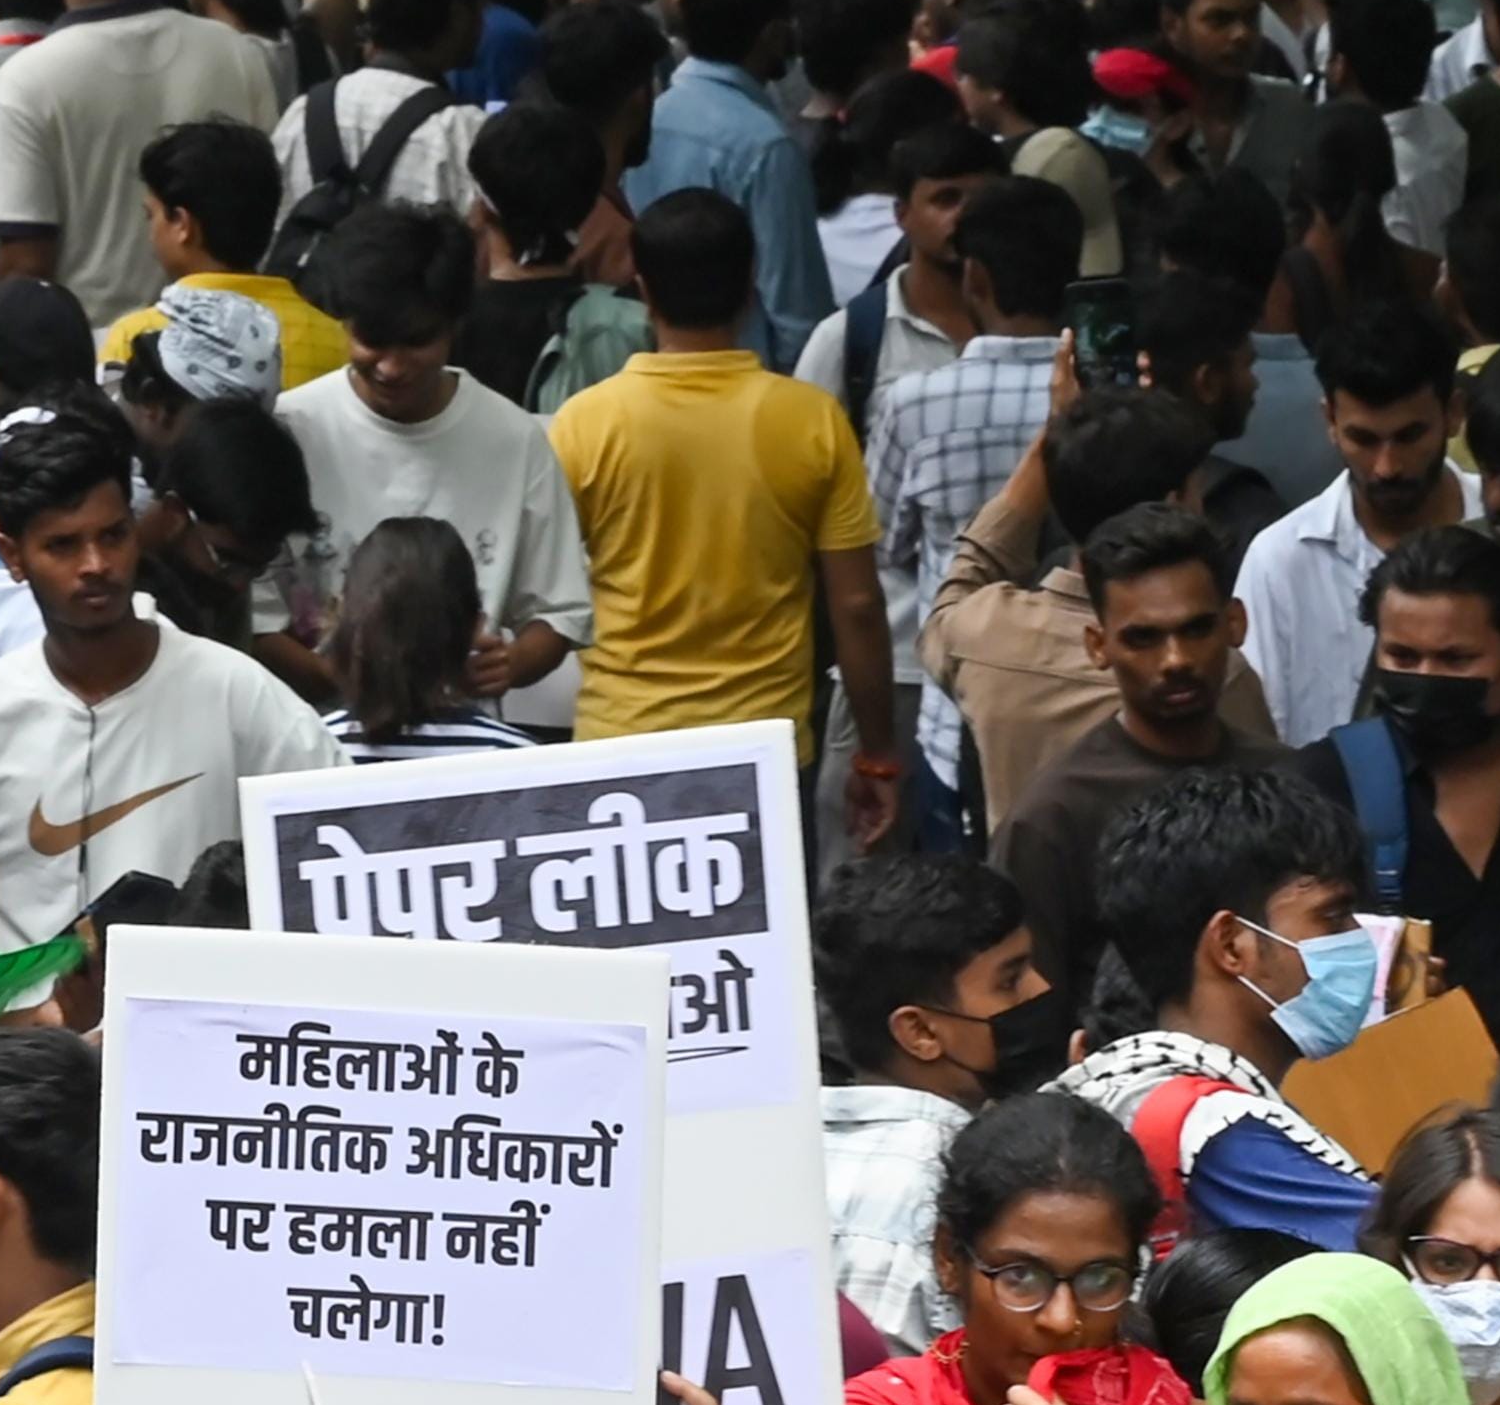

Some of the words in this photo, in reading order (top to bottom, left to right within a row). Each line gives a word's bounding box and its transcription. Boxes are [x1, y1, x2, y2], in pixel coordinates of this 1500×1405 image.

[298, 824, 505, 941] पेपर
[516, 791, 751, 933] लीक
[235, 1023, 460, 1097] महिलाओं
[474, 1033, 523, 1099] के
[137, 1102, 394, 1174] राजनीतिक
[405, 1116, 620, 1190] अधिकारों
[205, 1199, 277, 1253] पर
[286, 1204, 430, 1262] हमला
[442, 1200, 551, 1268] नहीं
[287, 1275, 446, 1345] चलेगा!
